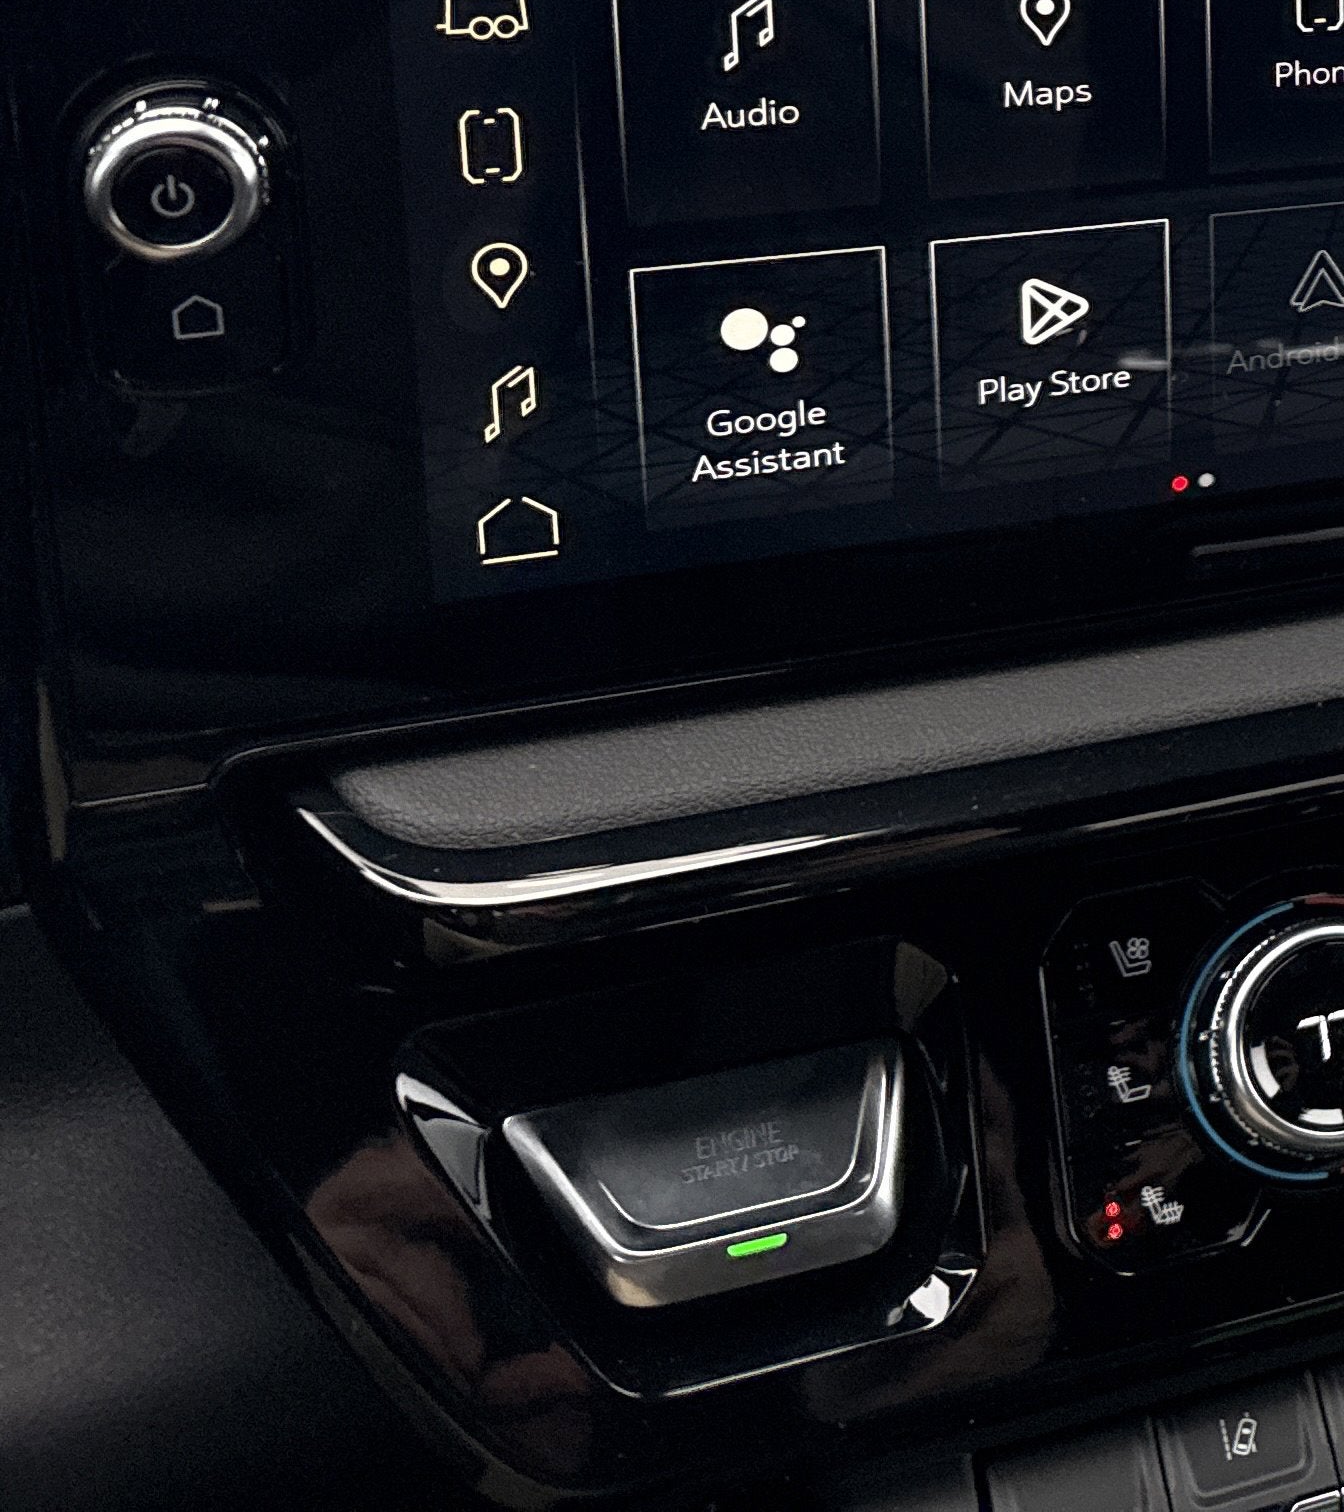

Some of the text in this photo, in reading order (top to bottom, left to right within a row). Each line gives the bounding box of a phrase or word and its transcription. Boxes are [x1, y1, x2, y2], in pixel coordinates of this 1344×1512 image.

[700, 97, 800, 131] Audio
[1004, 80, 1093, 112] Maps
[1226, 335, 1340, 375] Android
[978, 367, 1132, 408] Play Store
[706, 399, 827, 438] Google
[691, 441, 847, 483] Assistant
